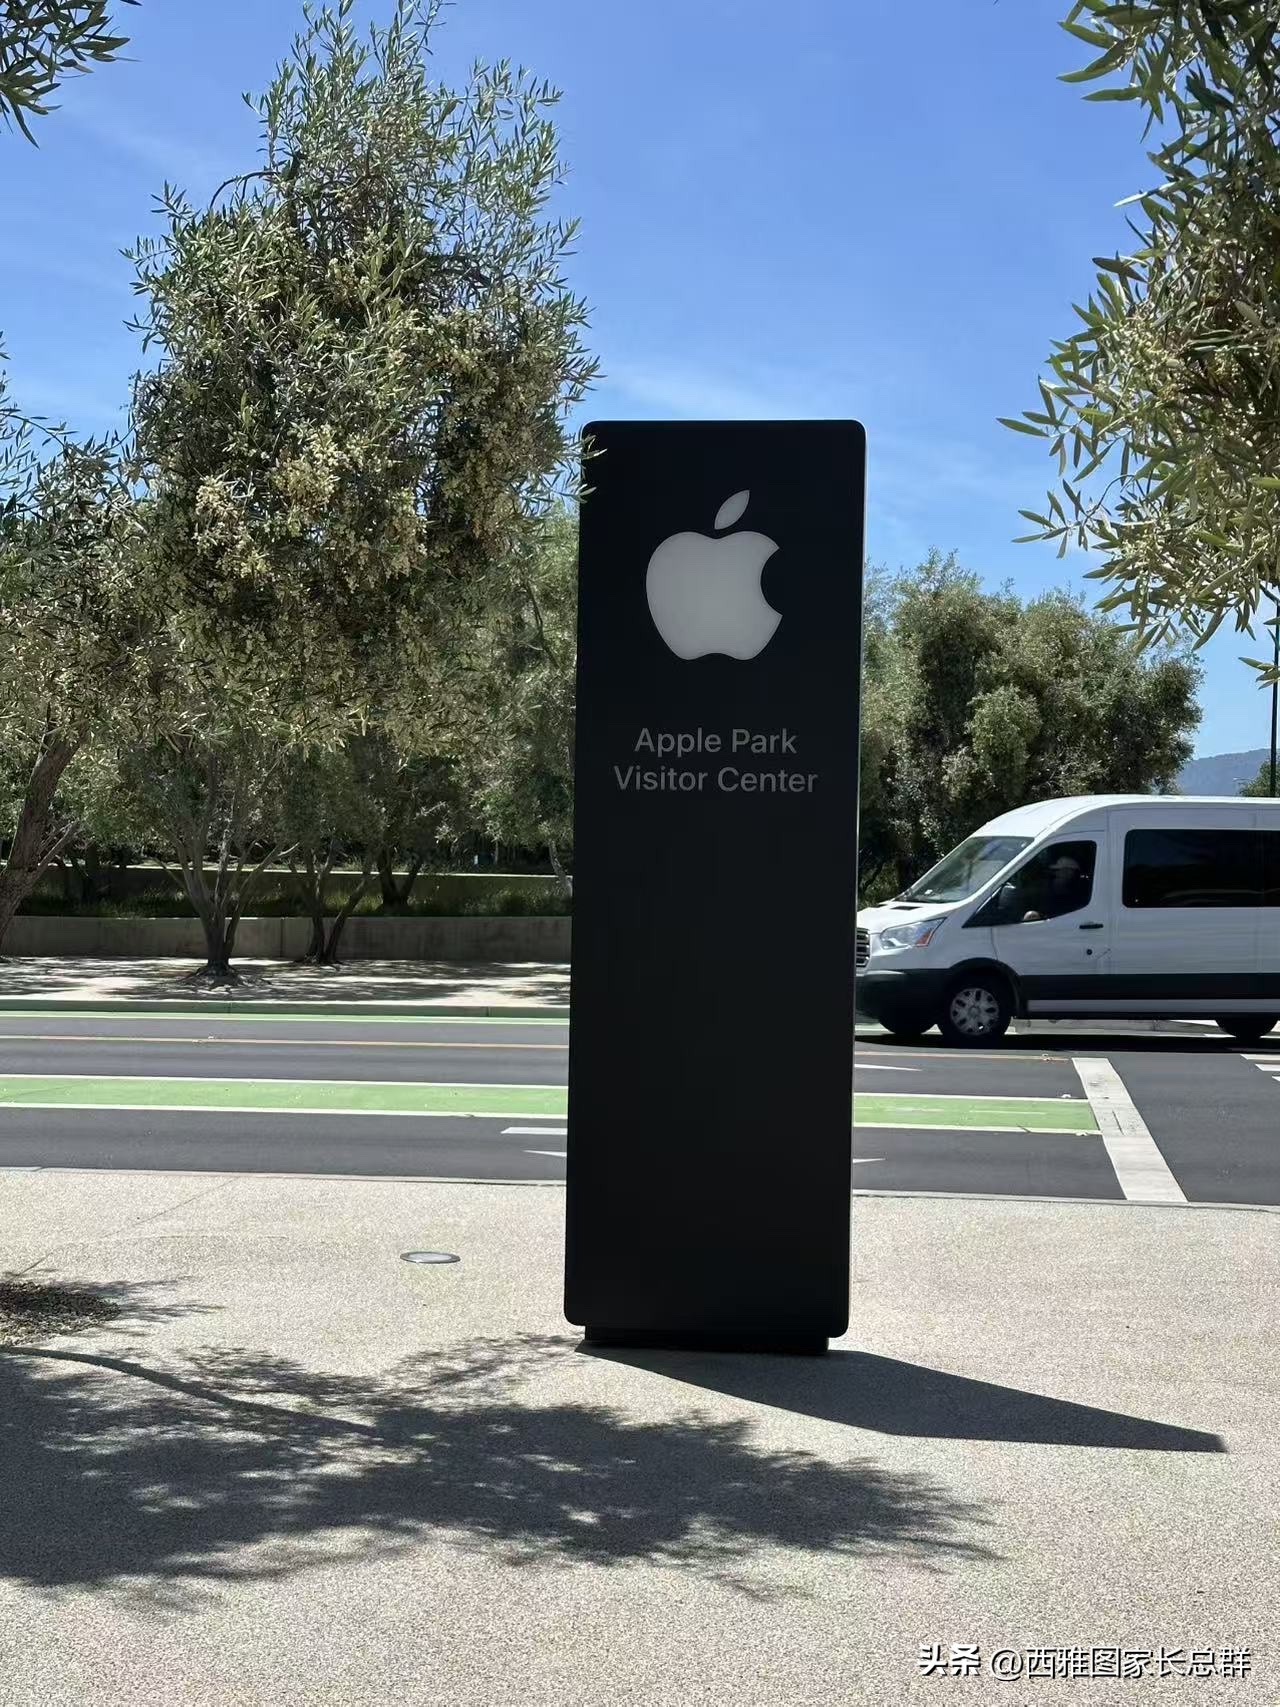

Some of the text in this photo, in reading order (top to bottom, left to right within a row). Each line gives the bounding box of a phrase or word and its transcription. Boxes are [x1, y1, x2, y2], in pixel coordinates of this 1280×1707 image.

[634, 727, 798, 758] Apple Park
[613, 765, 819, 793] Visitor Center
